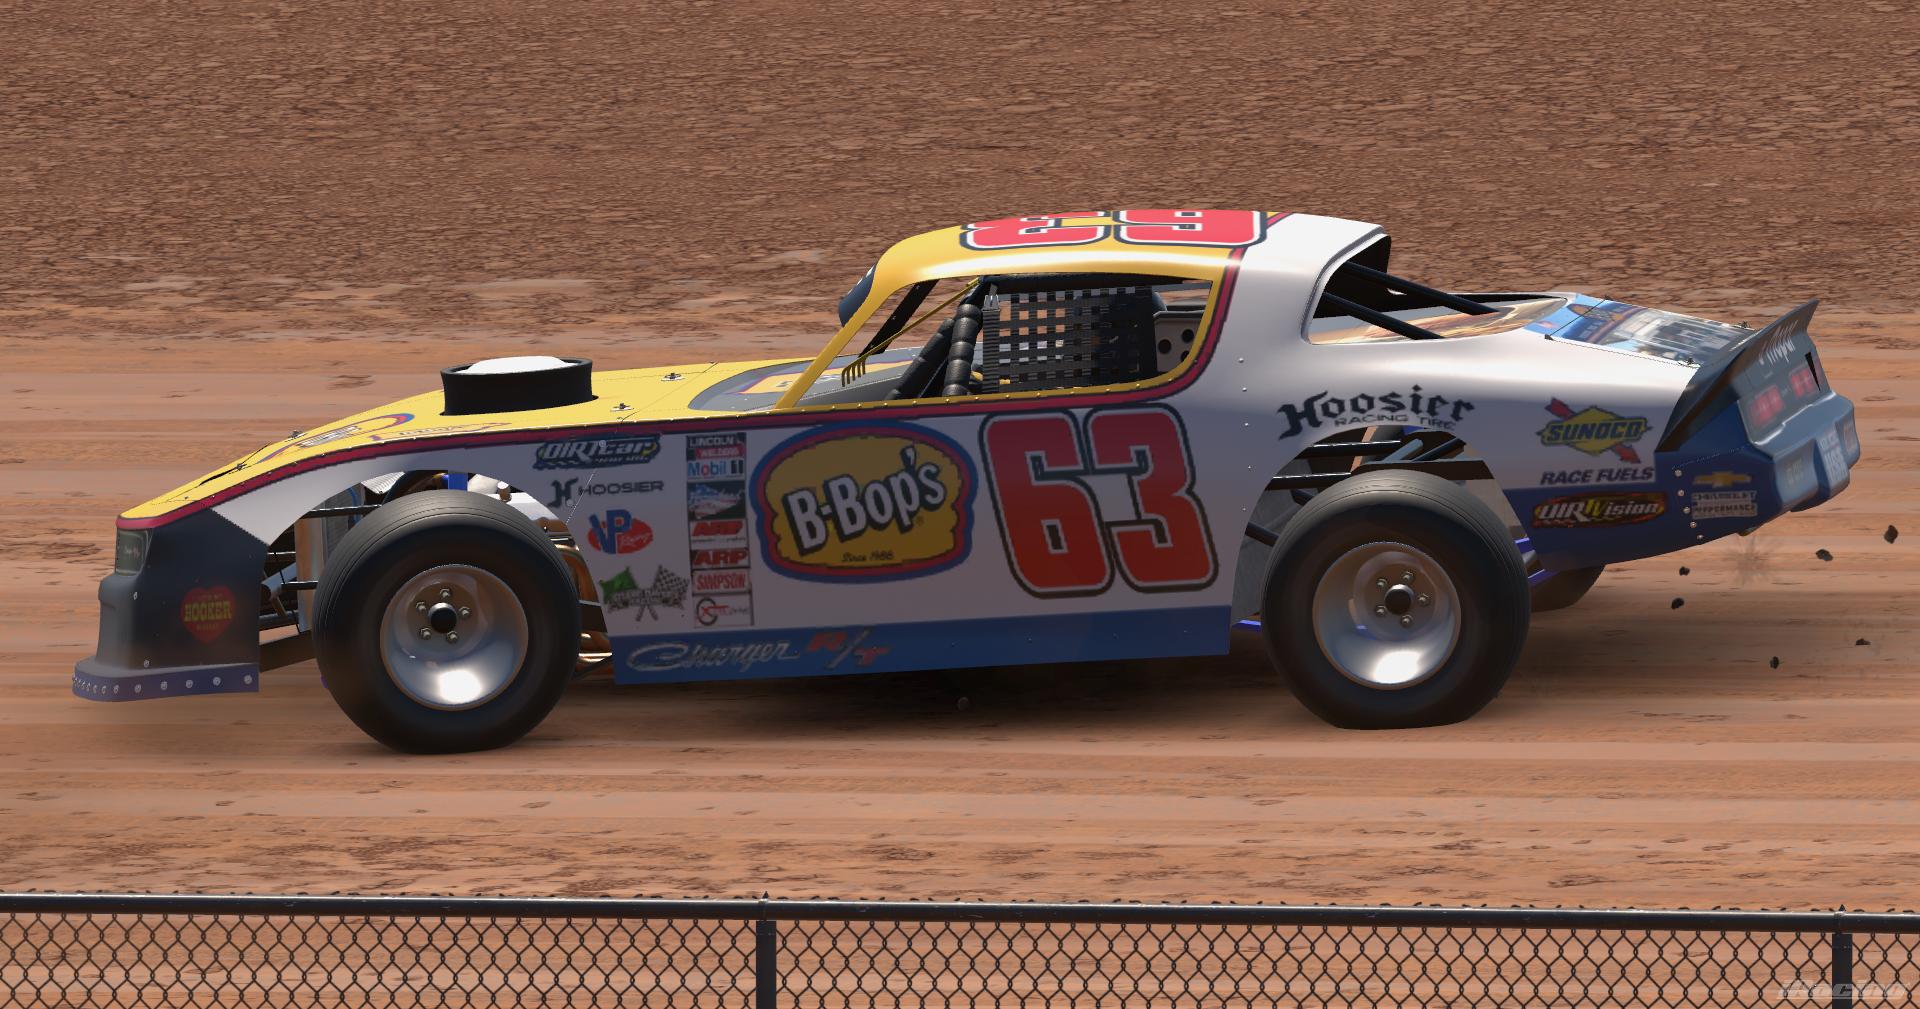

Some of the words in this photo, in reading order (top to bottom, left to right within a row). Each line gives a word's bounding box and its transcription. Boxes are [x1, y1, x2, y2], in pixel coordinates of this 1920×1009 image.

[1277, 384, 1475, 441] Hoosier
[1335, 414, 1408, 427] RACING
[1420, 415, 1456, 431] TIRE
[1549, 421, 1642, 441] SUNOCO
[689, 435, 736, 447] LINCOLN
[688, 461, 727, 476] Mobil
[1540, 469, 1593, 485] RACE
[1596, 467, 1655, 482] FUELS
[578, 480, 665, 495] HOOSIER
[786, 446, 947, 553] B-Bop's
[979, 404, 1218, 598] 63
[589, 509, 632, 554] VP
[694, 549, 748, 566] ARP
[697, 573, 746, 590] SIMPSON
[184, 601, 232, 622] HOOKER
[626, 643, 800, 673] Charger
